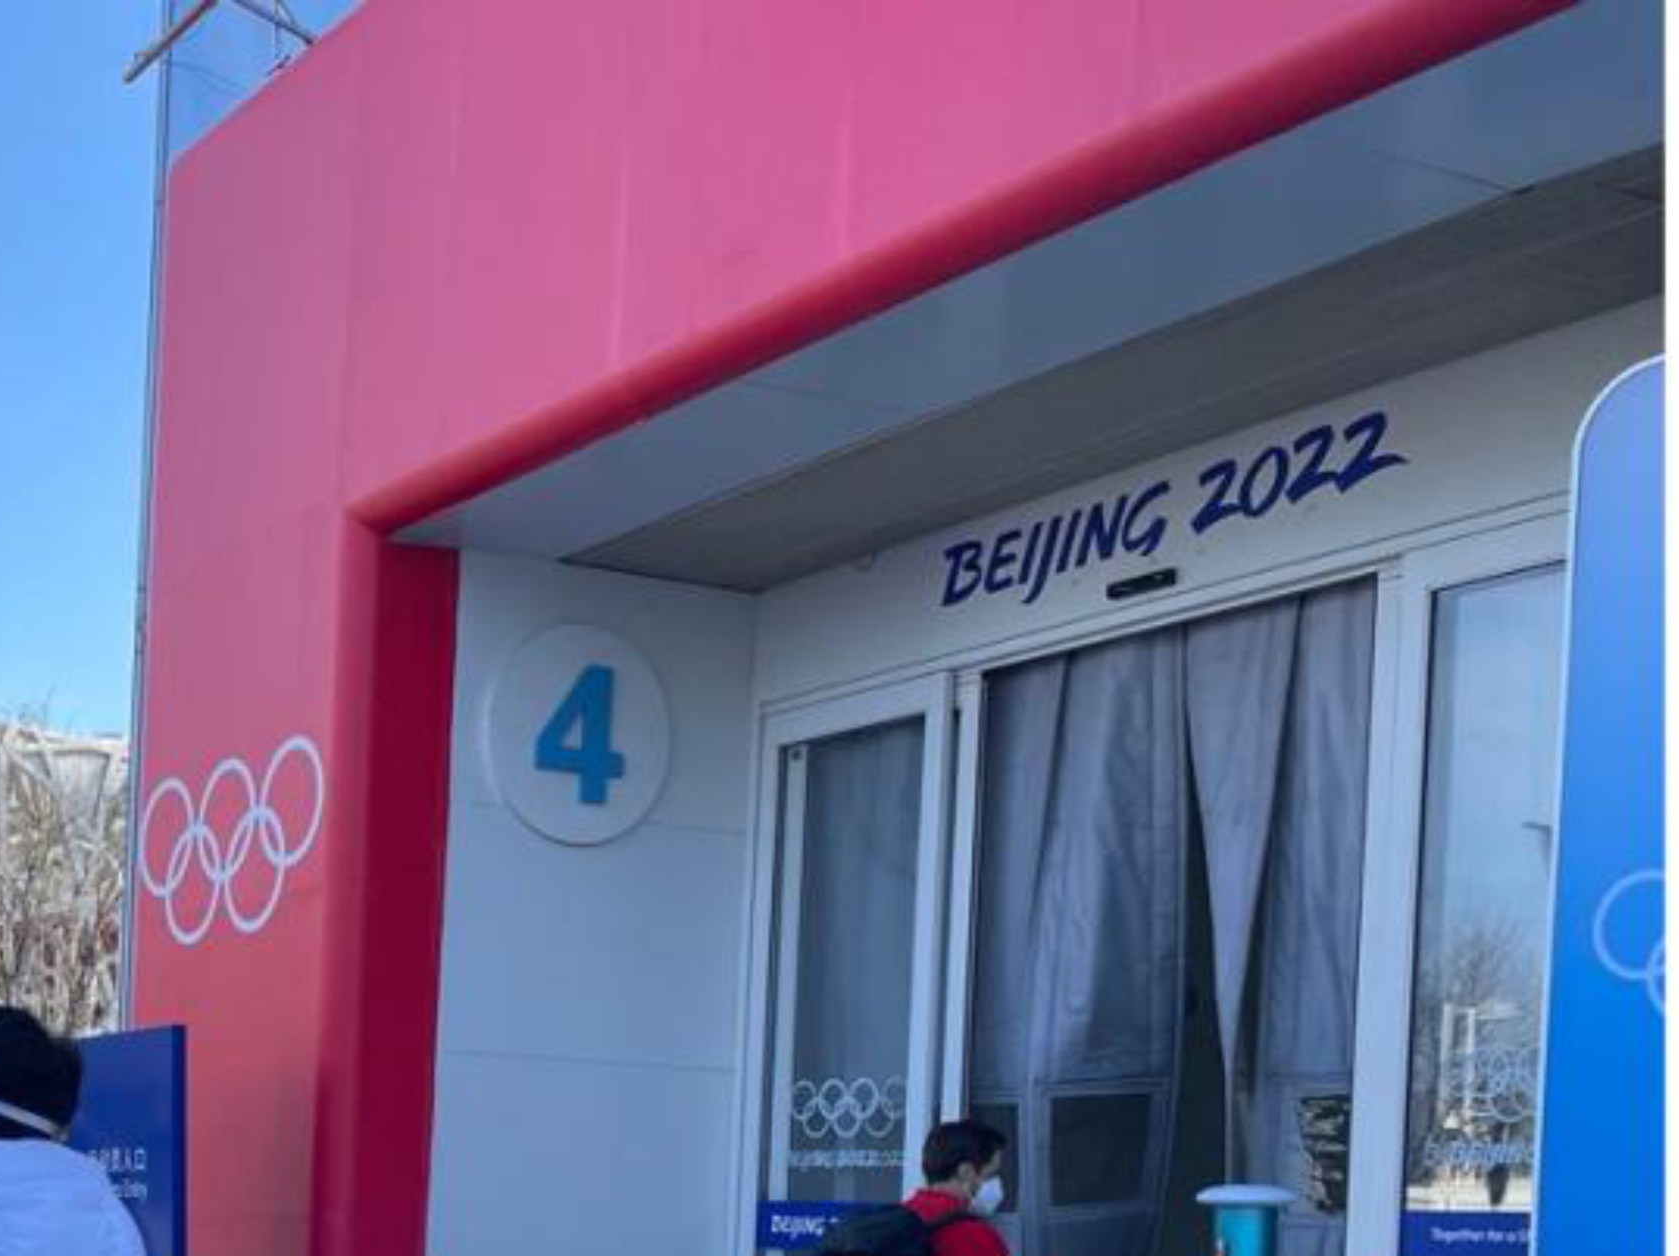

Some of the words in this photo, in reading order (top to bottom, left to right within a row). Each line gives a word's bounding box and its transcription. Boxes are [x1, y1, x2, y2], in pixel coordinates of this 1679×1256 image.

[942, 480, 1170, 605] BEIJING
[1191, 412, 1408, 535] 2022
[534, 662, 626, 804] 4
